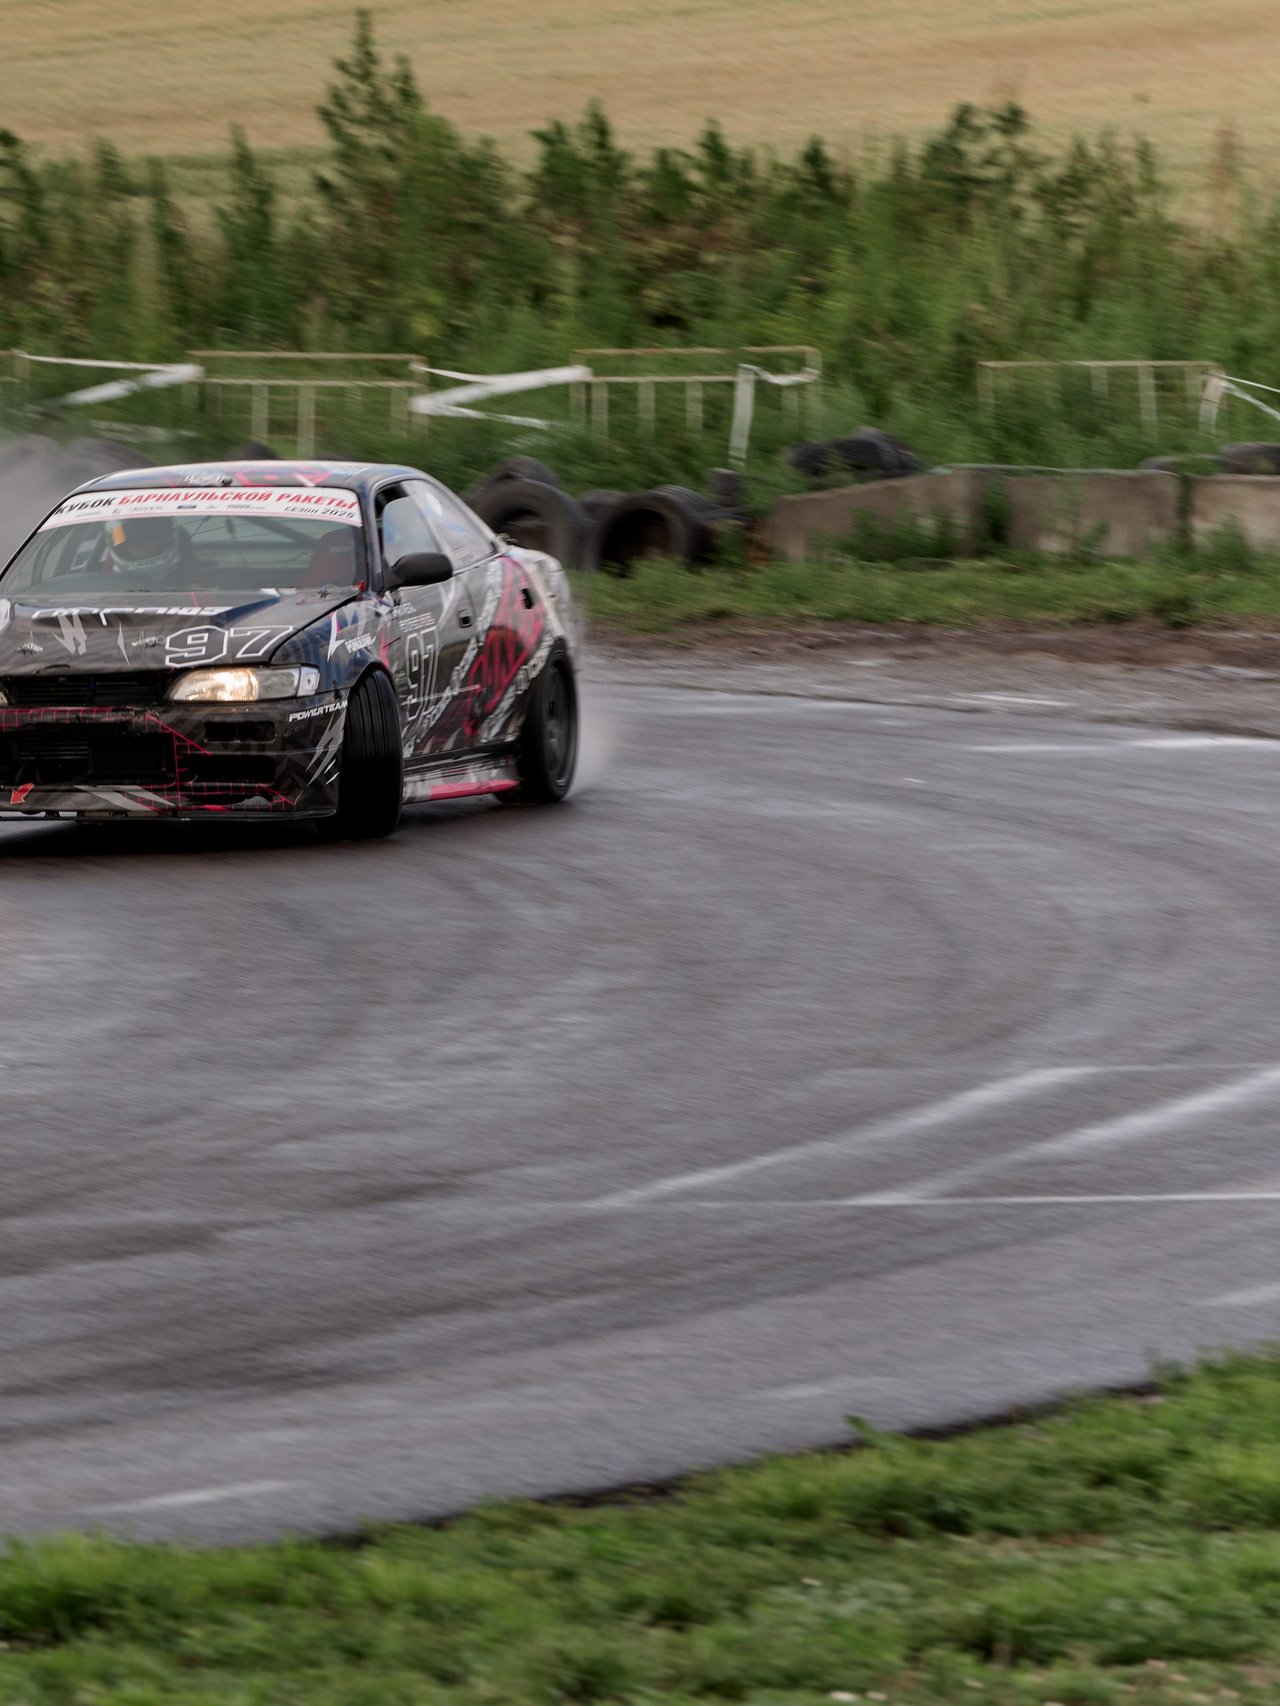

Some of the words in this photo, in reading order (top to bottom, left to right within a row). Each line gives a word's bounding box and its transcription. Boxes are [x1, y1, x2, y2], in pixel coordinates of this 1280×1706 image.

[54, 496, 117, 516] КУБОК
[118, 490, 274, 506] БАРНАУЛЬСКОЙ
[276, 493, 359, 510] РАКЕТЫ
[321, 508, 357, 518] 2025
[165, 624, 294, 669] 97
[406, 626, 440, 721] 97
[288, 699, 349, 723] POWERTEAM
